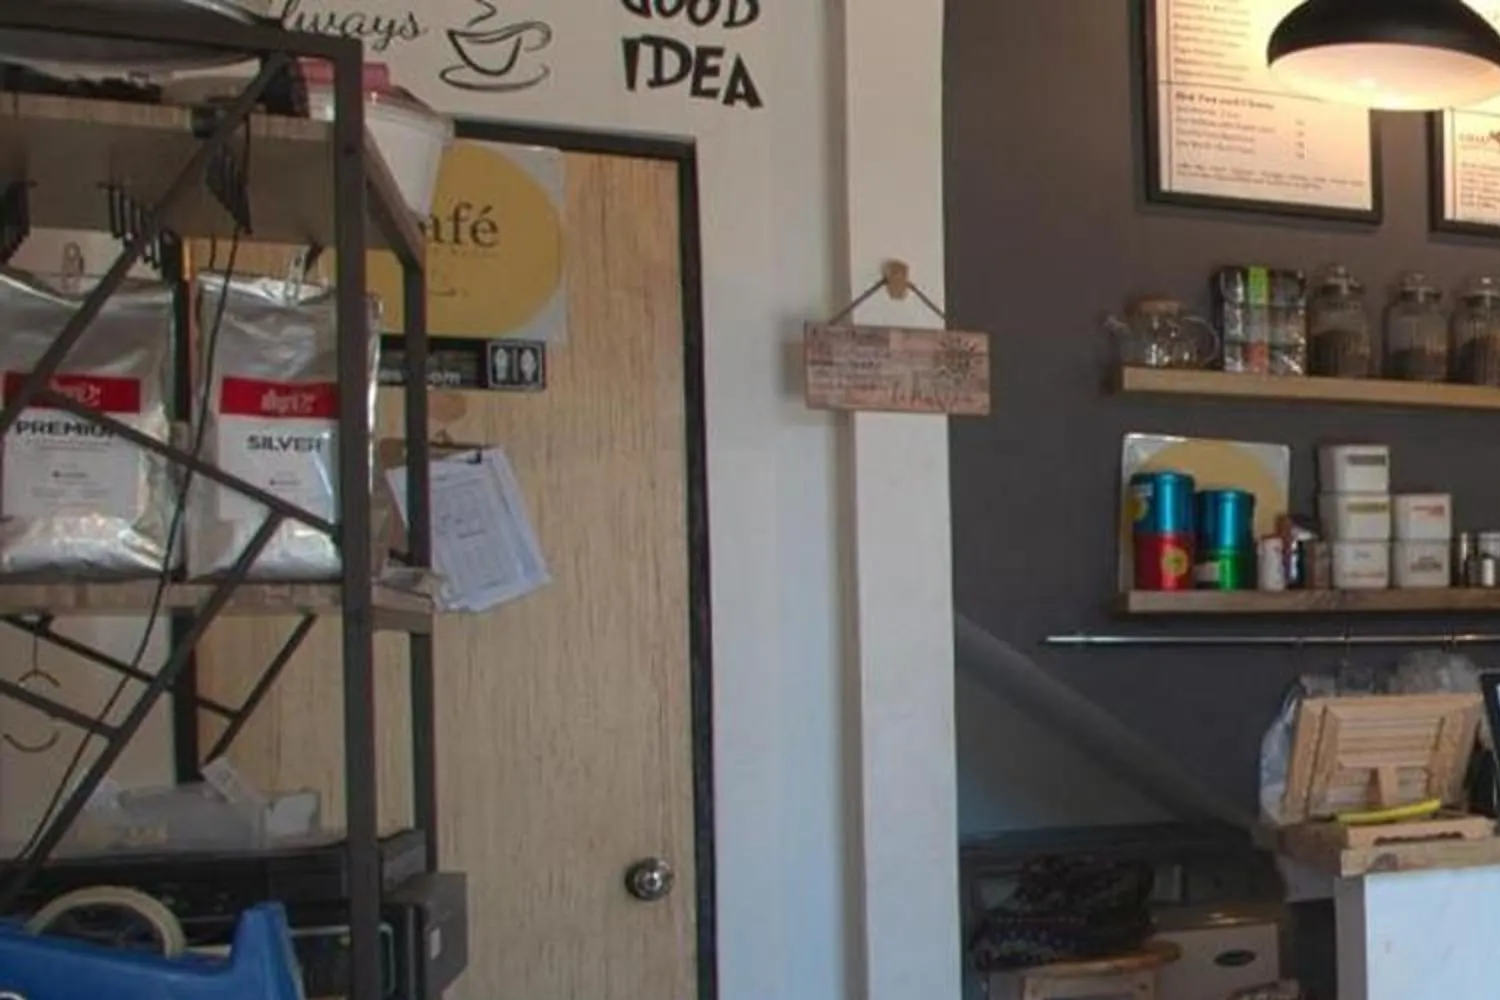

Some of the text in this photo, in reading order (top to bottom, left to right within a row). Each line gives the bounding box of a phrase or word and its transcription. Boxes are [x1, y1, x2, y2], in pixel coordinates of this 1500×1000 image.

[281, 0, 418, 51] lways
[621, 34, 764, 109] IDEA
[419, 202, 499, 248] afé
